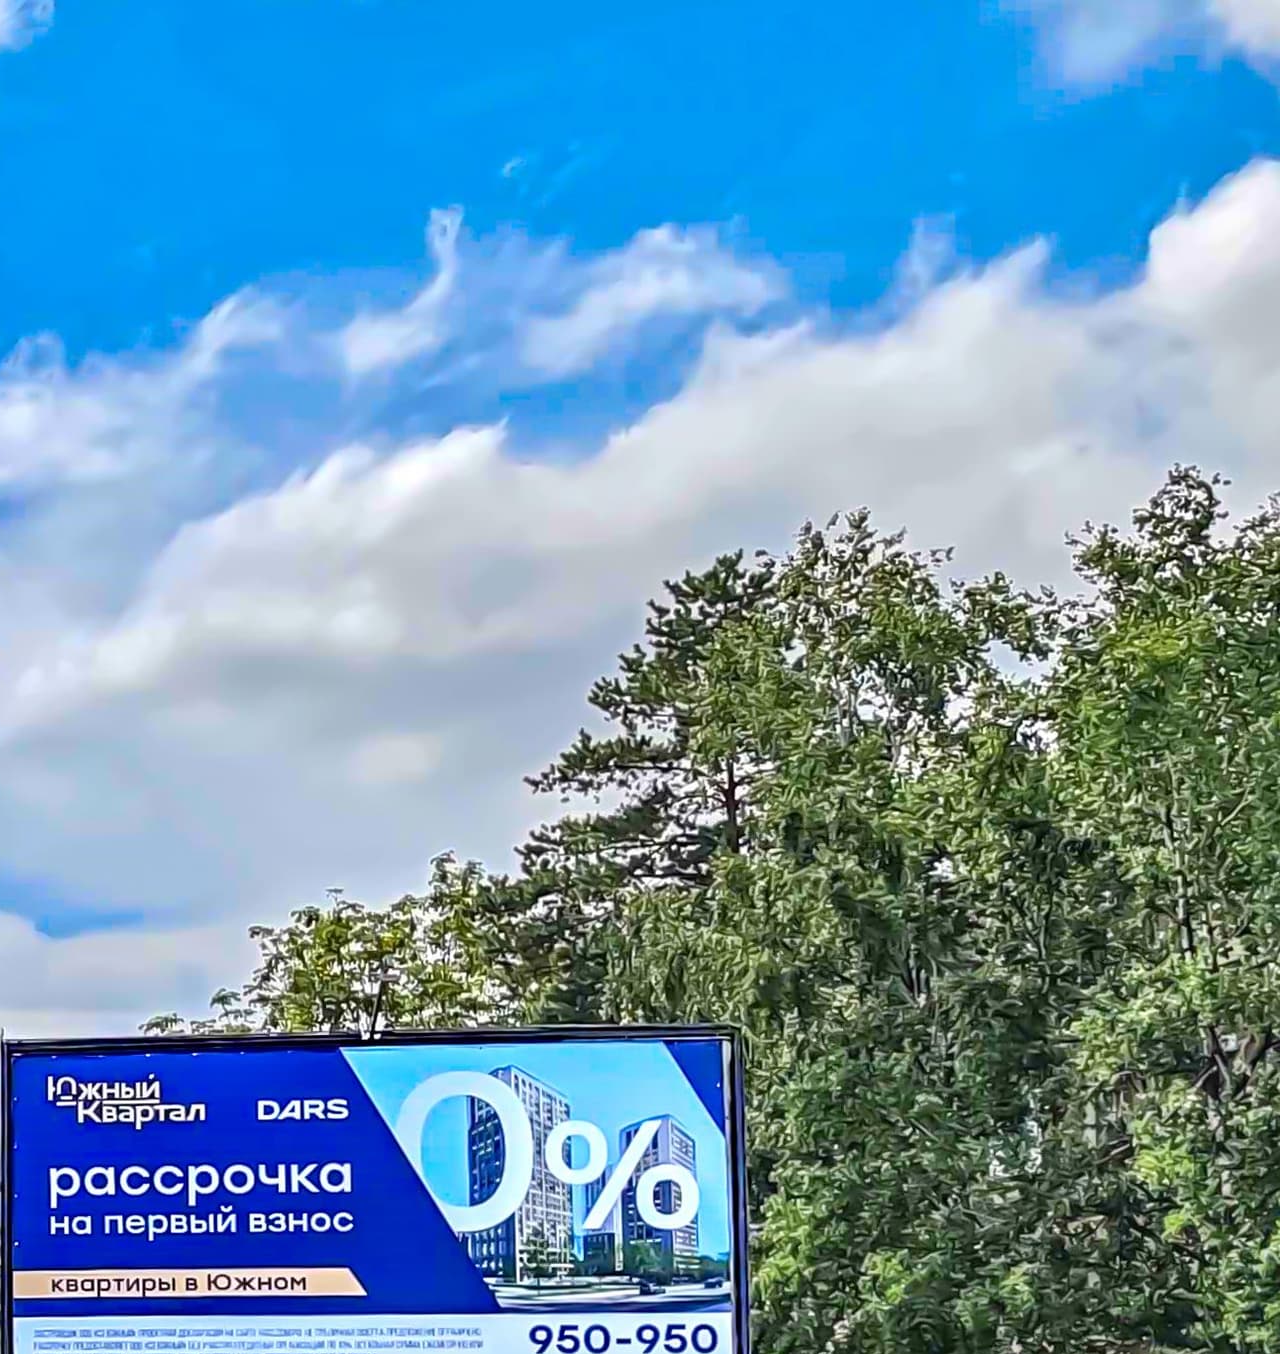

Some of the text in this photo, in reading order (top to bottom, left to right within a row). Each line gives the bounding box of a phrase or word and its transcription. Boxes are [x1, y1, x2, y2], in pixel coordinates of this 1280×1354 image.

[47, 1073, 161, 1105] Южный
[76, 1102, 207, 1130] Квартал
[256, 1098, 350, 1121] DARS
[395, 1070, 700, 1232] 0%
[48, 1162, 353, 1209] рассрочка
[49, 1205, 355, 1242] на первый взнос
[50, 1272, 308, 1298] квартиры в Южном
[528, 1324, 720, 1354] 950-950
